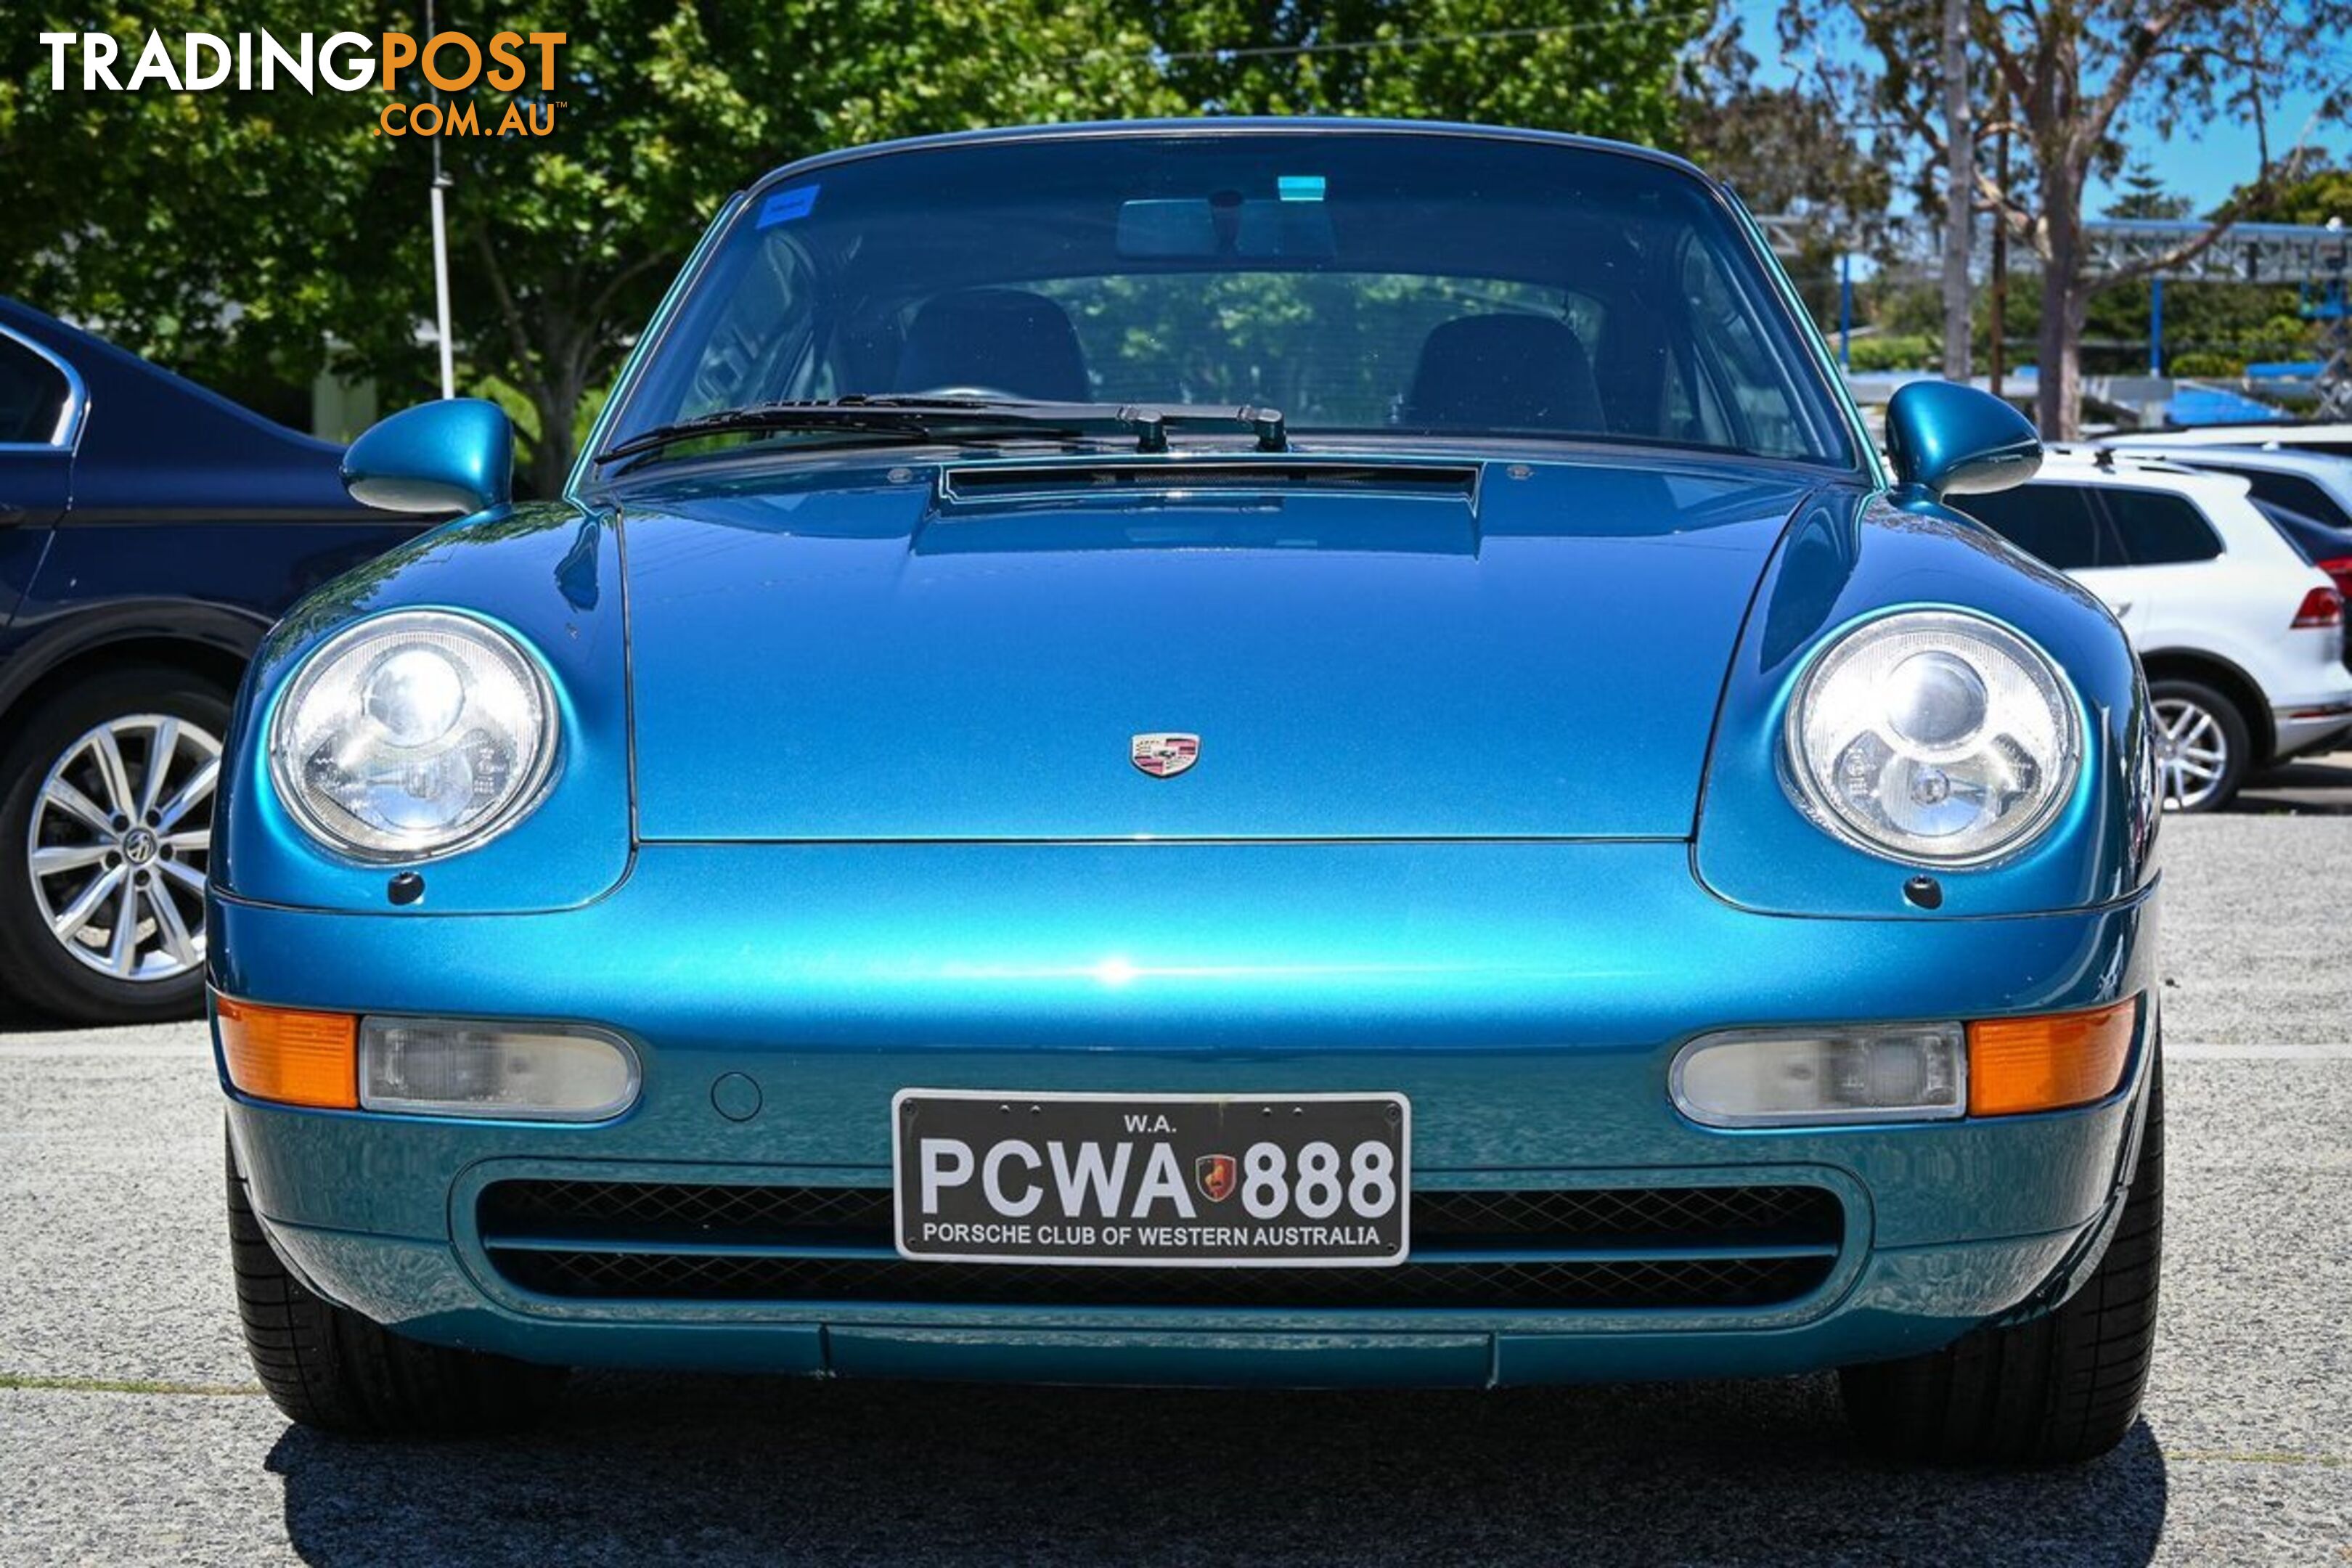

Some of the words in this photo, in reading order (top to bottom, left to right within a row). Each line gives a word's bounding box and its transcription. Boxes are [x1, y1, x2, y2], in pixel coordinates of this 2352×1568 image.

[1124, 1114, 1177, 1132] W.A.
[920, 1138, 1197, 1218] PCWA
[1241, 1140, 1396, 1219] 888
[923, 1222, 1032, 1244] PORSCHE
[1037, 1225, 1095, 1245] CLUB
[1102, 1226, 1132, 1246] OF
[1138, 1227, 1248, 1246] WESTERN
[1253, 1226, 1380, 1246] AUSTRALIA
